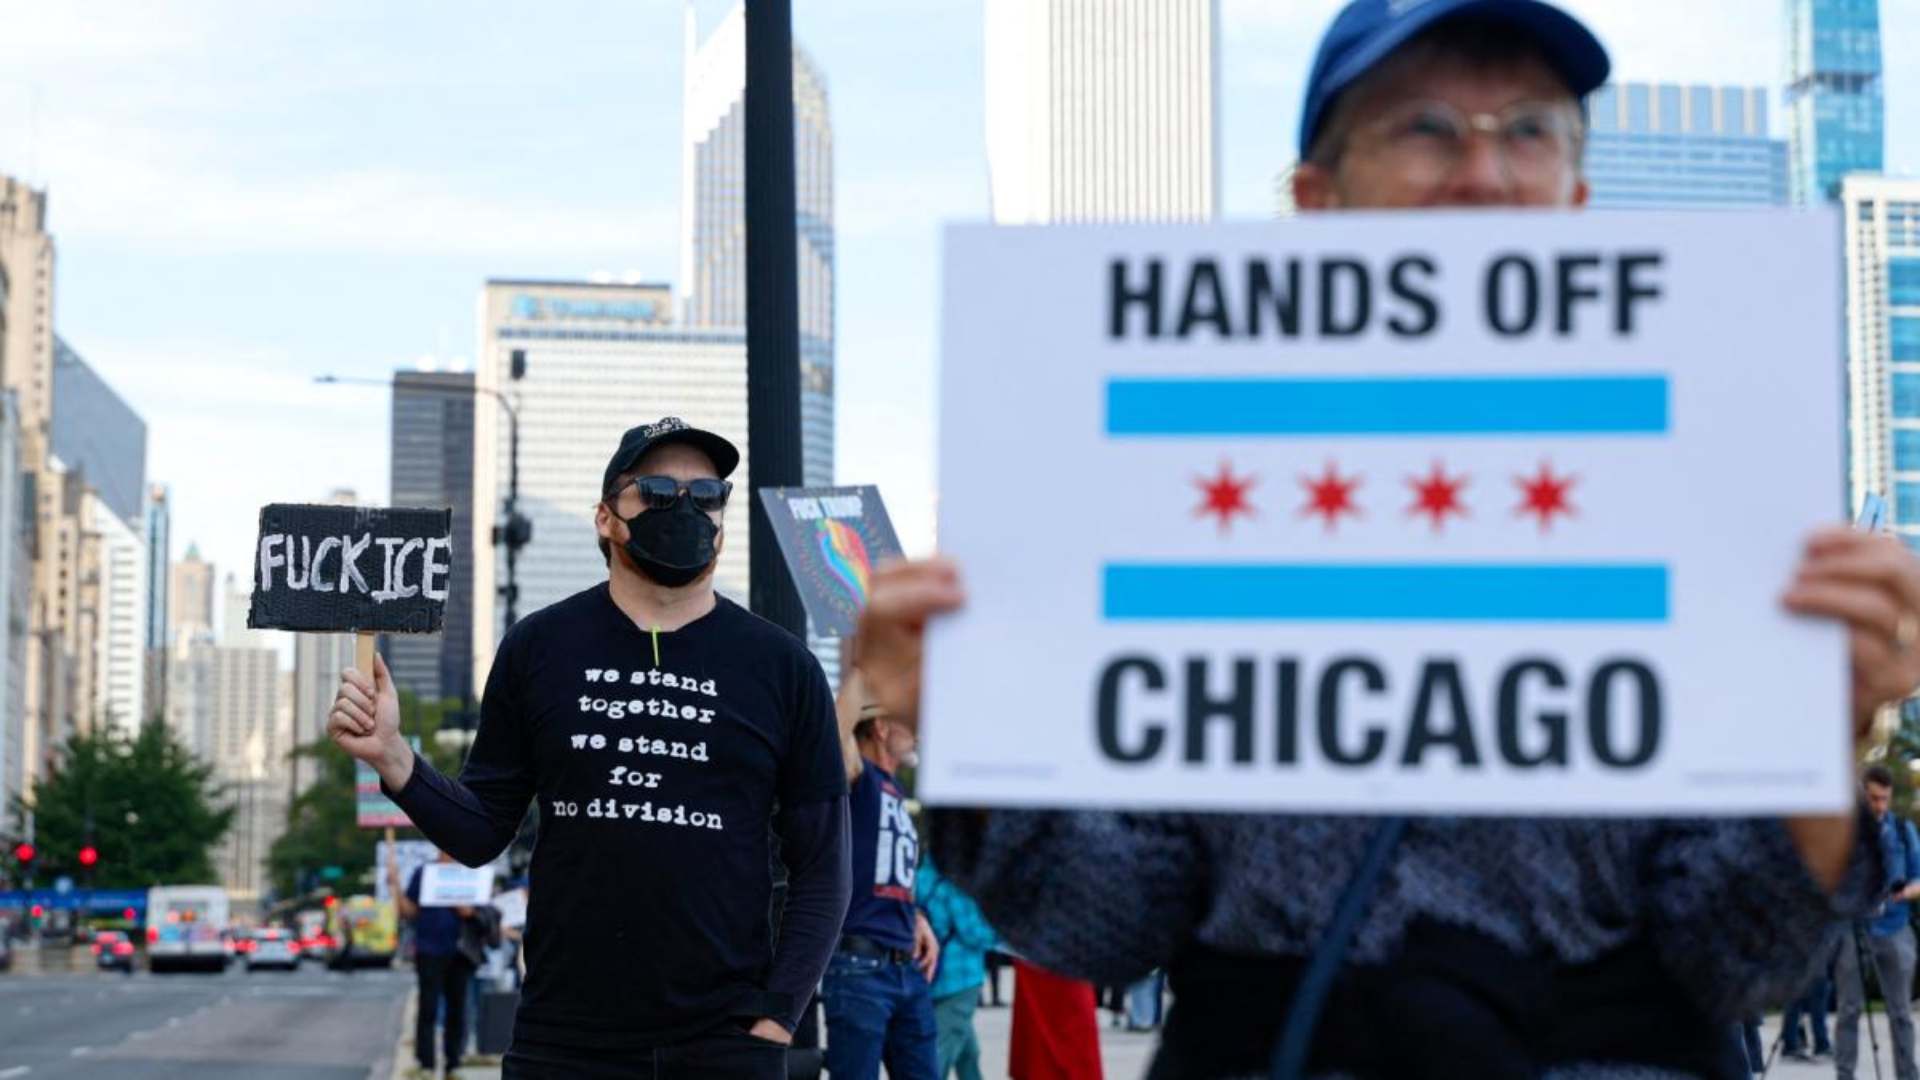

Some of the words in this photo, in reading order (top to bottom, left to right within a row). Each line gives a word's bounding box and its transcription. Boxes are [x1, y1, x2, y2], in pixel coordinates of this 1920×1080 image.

[1106, 255, 1440, 340] HANDS
[1484, 252, 1665, 337] OFF
[260, 533, 371, 593] FUCK
[371, 535, 452, 604] ICE
[585, 668, 621, 683] we
[630, 667, 718, 697] stand
[578, 694, 716, 724] together
[1094, 654, 1664, 771] CHICAGO
[571, 733, 608, 750] we
[617, 735, 710, 762] stand
[608, 765, 663, 789] for
[552, 800, 579, 817] no
[586, 798, 724, 830] division
